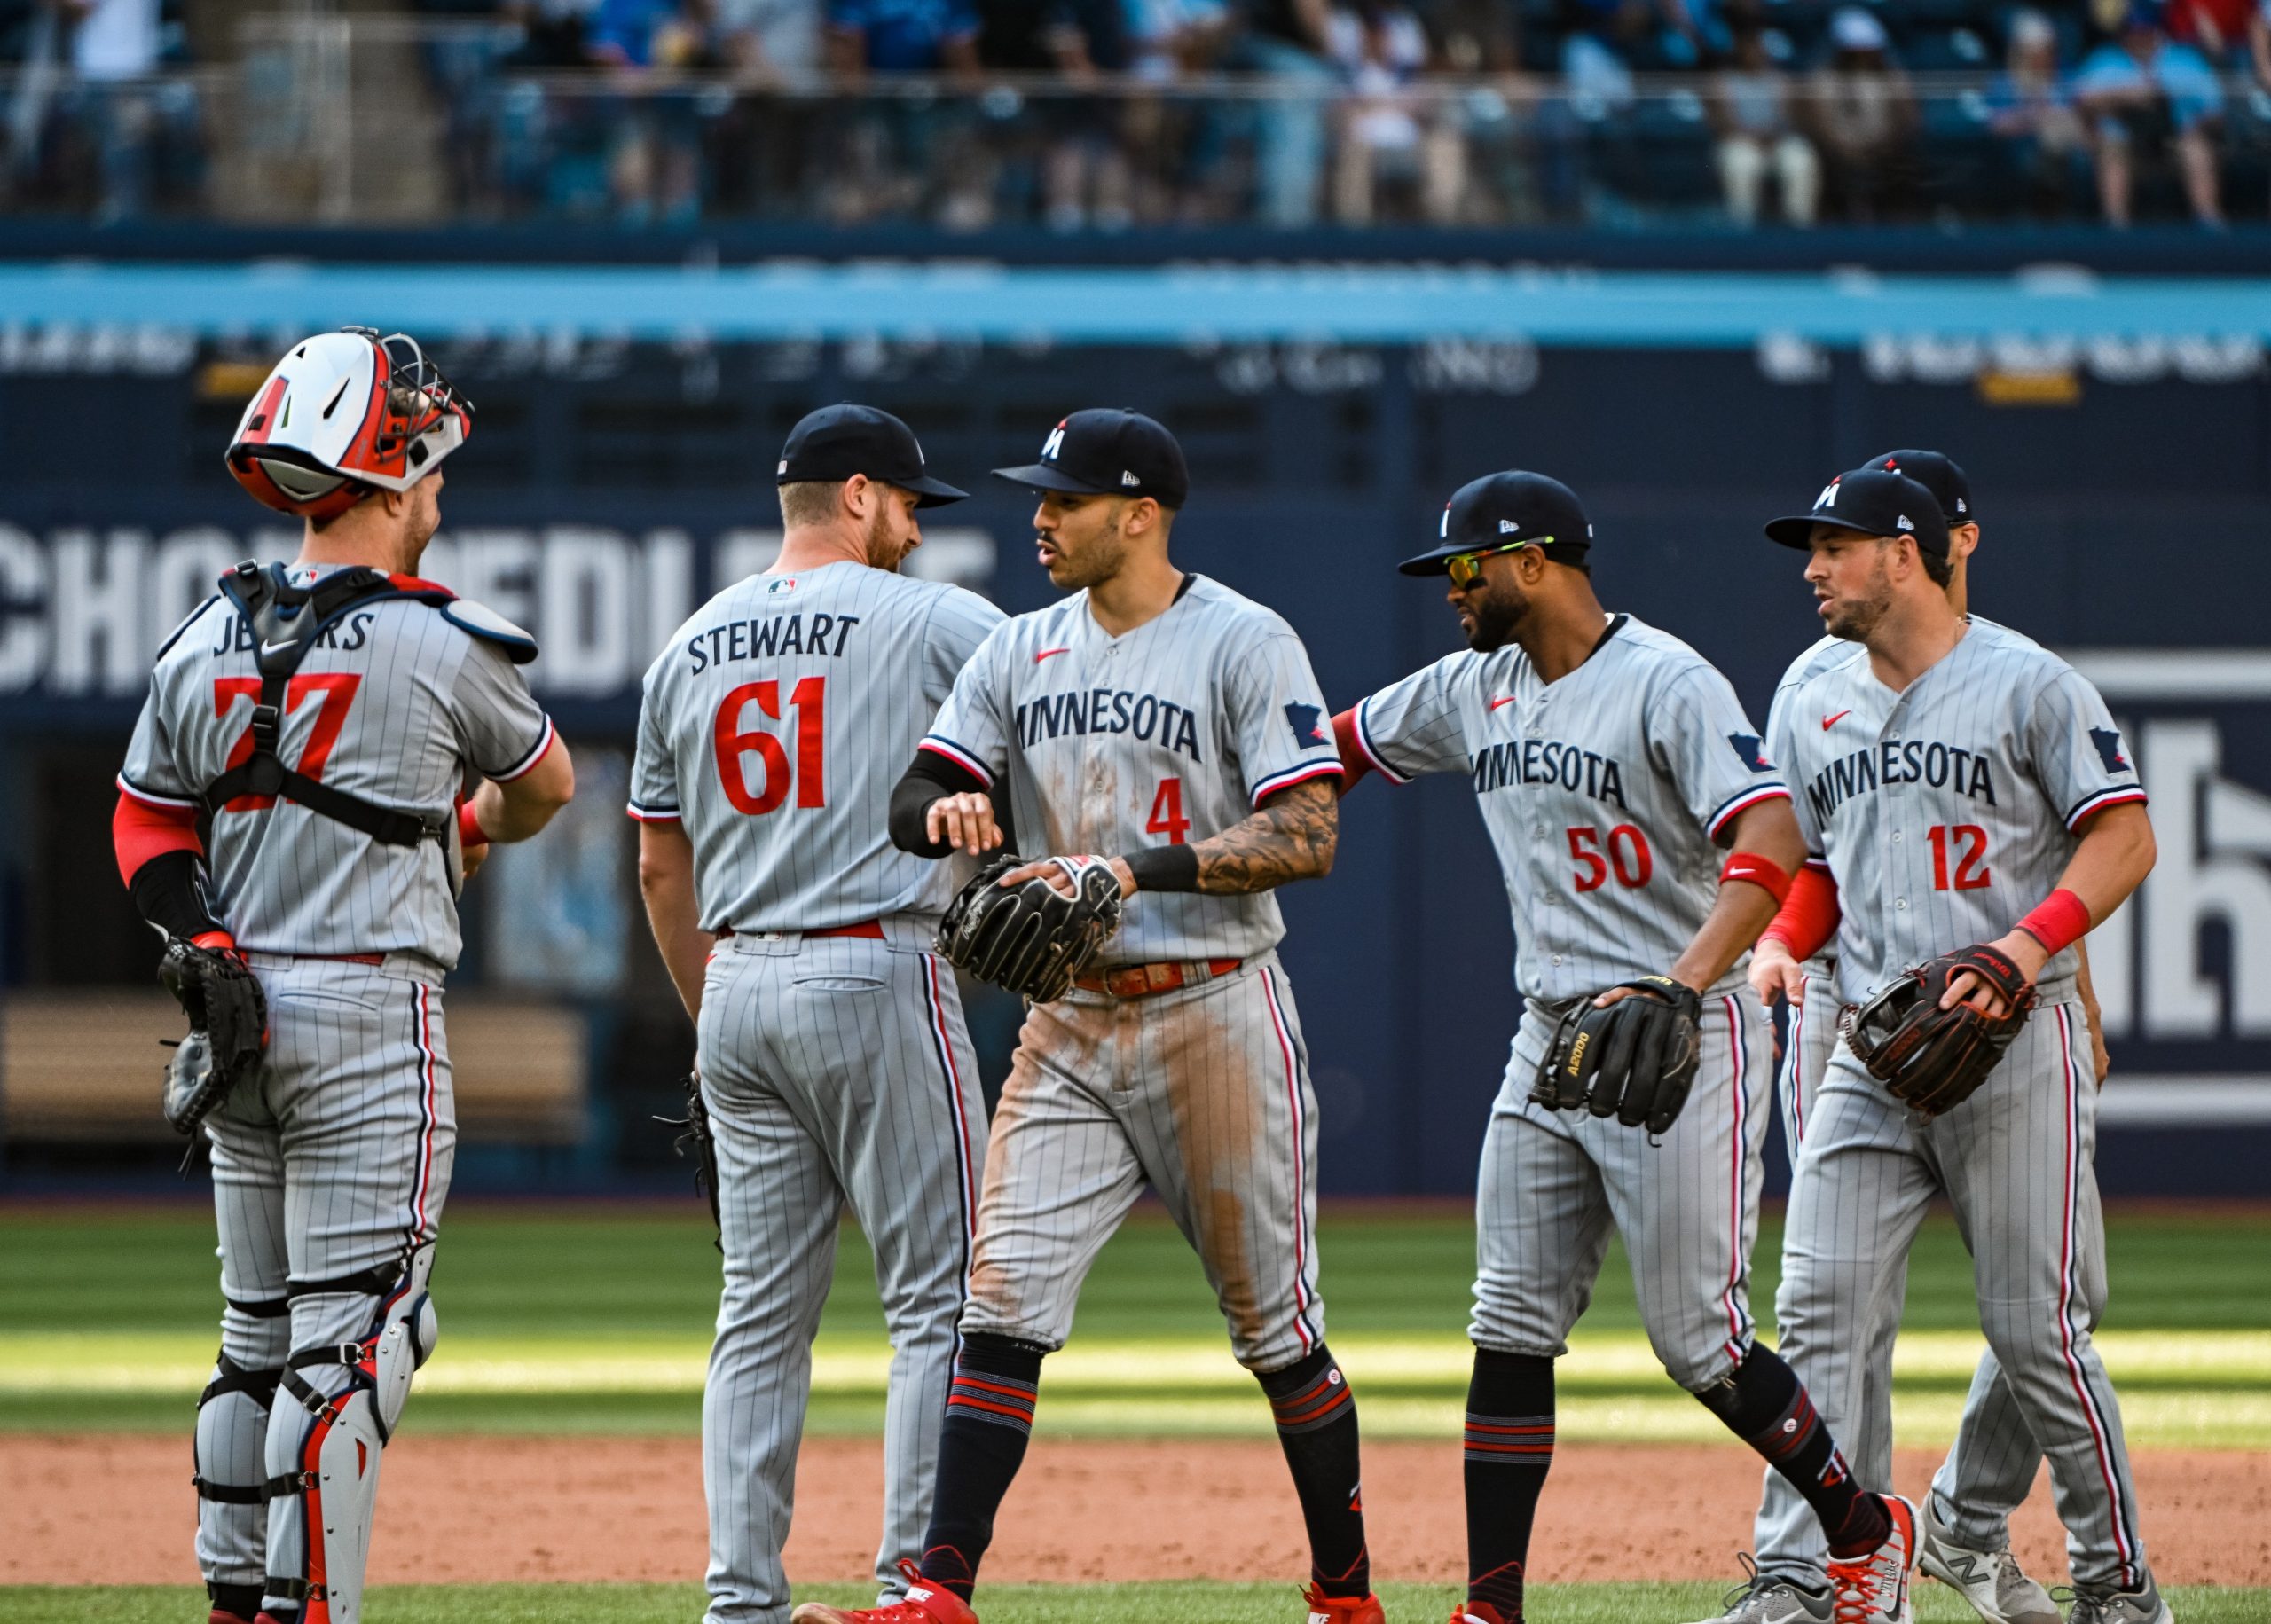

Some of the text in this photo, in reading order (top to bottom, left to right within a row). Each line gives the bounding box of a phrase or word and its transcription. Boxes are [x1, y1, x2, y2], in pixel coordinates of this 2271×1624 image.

[214, 613, 373, 657] JERS
[688, 613, 860, 676] STEWART
[714, 676, 826, 816] 61
[1146, 777, 1191, 846] 4
[1807, 741, 1998, 834] MINNESOTA
[1566, 823, 1654, 892] 50
[1926, 824, 1992, 891] 12
